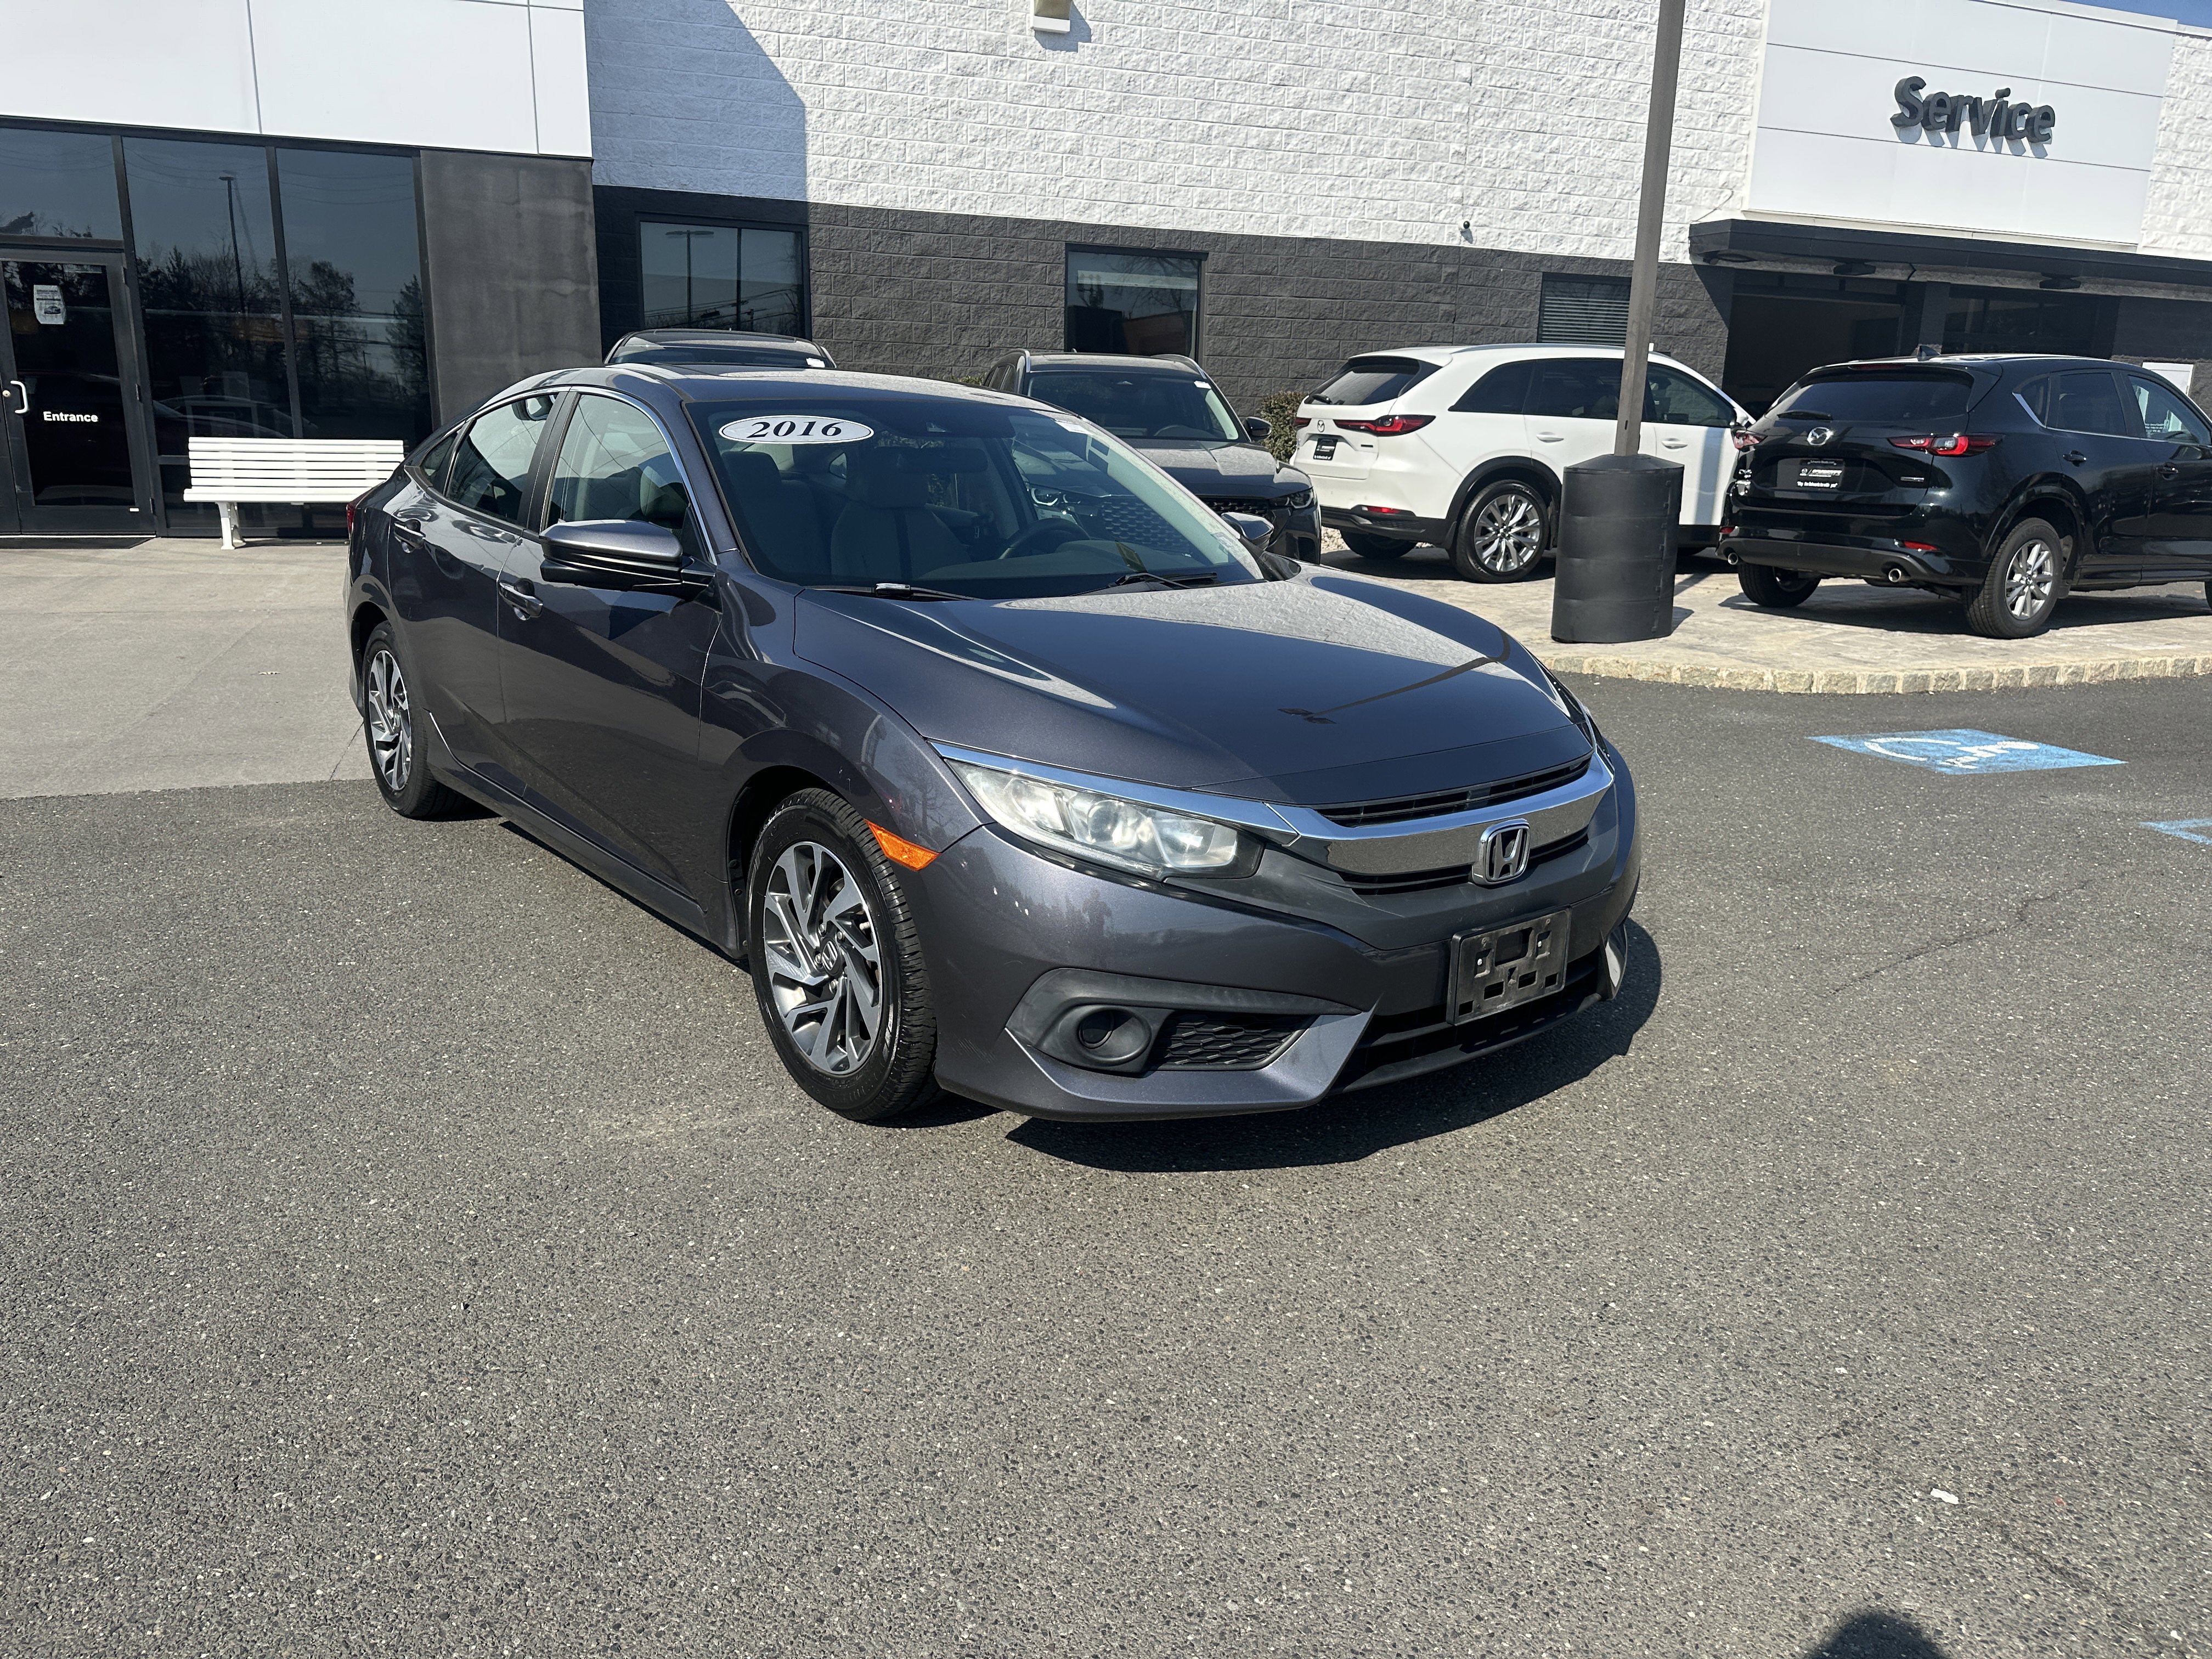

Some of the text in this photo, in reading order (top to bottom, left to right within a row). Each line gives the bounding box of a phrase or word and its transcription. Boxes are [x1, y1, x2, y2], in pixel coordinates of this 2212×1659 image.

[1890, 76, 2056, 143] Service
[43, 411, 98, 422] Entrance
[746, 420, 845, 438] 2016
